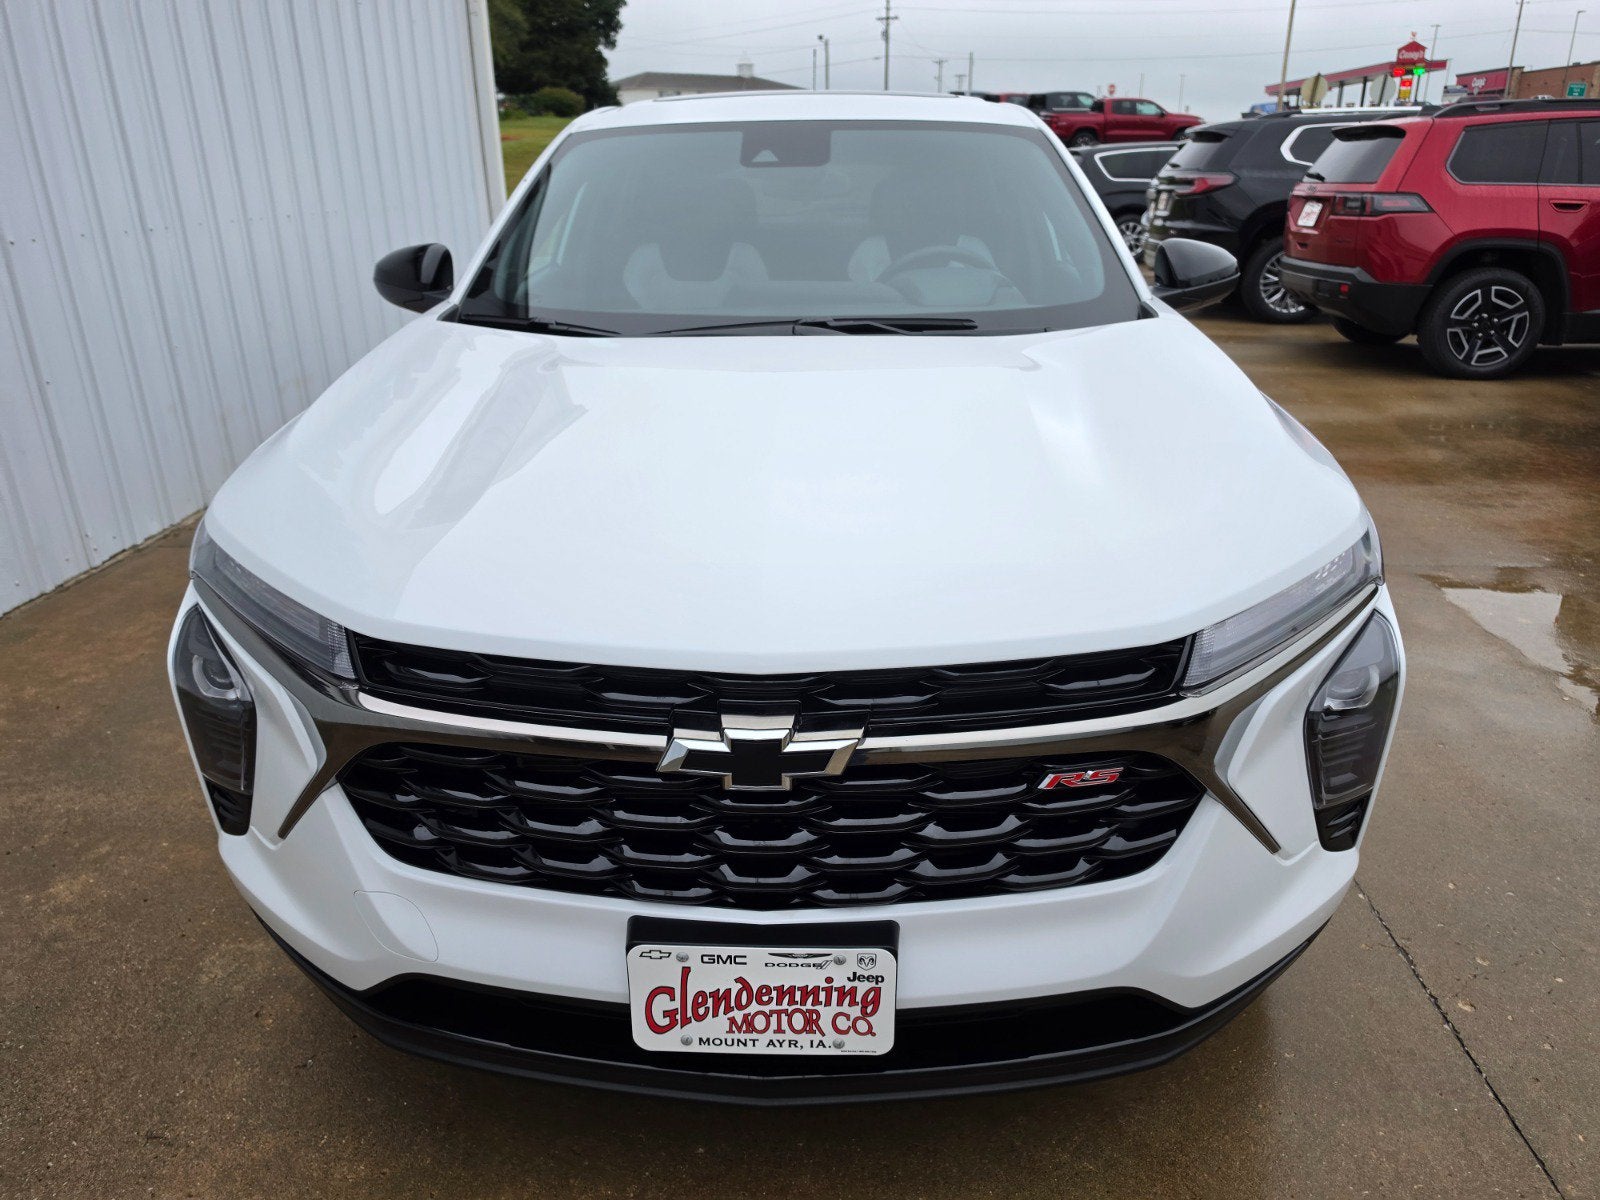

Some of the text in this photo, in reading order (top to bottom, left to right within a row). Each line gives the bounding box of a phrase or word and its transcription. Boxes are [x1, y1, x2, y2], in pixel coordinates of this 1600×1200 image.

[1037, 767, 1124, 790] RS
[701, 954, 747, 965] GMC
[847, 971, 885, 985] Jeep
[645, 966, 882, 1035] Glendenning
[726, 1008, 826, 1037] MOTOR
[698, 1038, 832, 1050] MOUNT AYR, IA.
